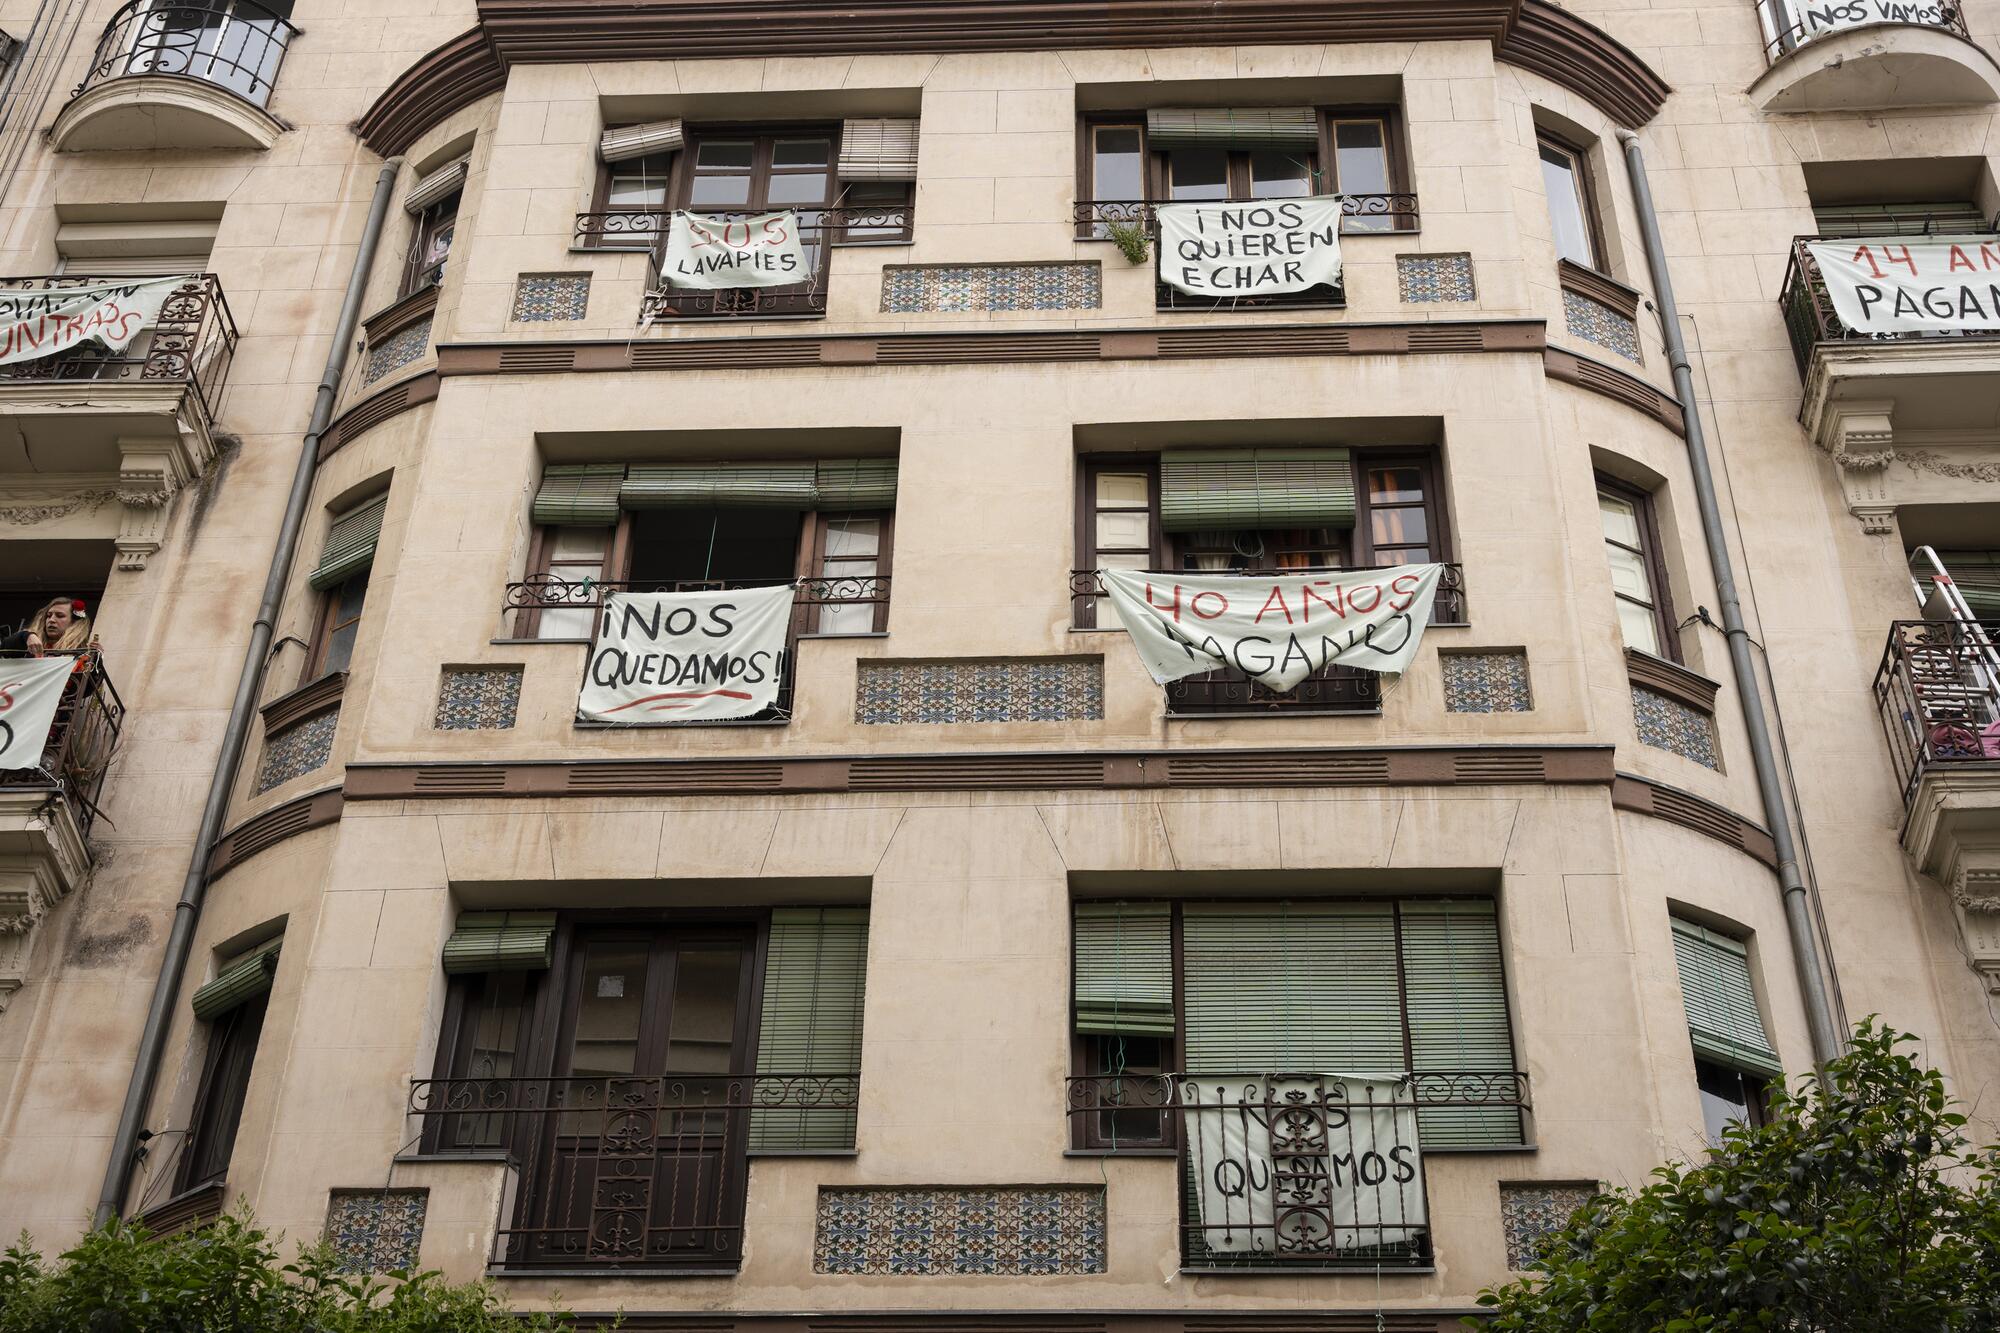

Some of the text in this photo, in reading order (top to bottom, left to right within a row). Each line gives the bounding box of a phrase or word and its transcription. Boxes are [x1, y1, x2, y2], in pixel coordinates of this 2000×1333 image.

[1807, 0, 1943, 31] NOS VAMOS
[677, 250, 797, 276] LAVAPIES
[1182, 261, 1305, 289] ECHAR
[1853, 244, 1918, 278] 14
[1254, 575, 1420, 625] AÑOS
[592, 647, 782, 689] QUEDAMOS!
